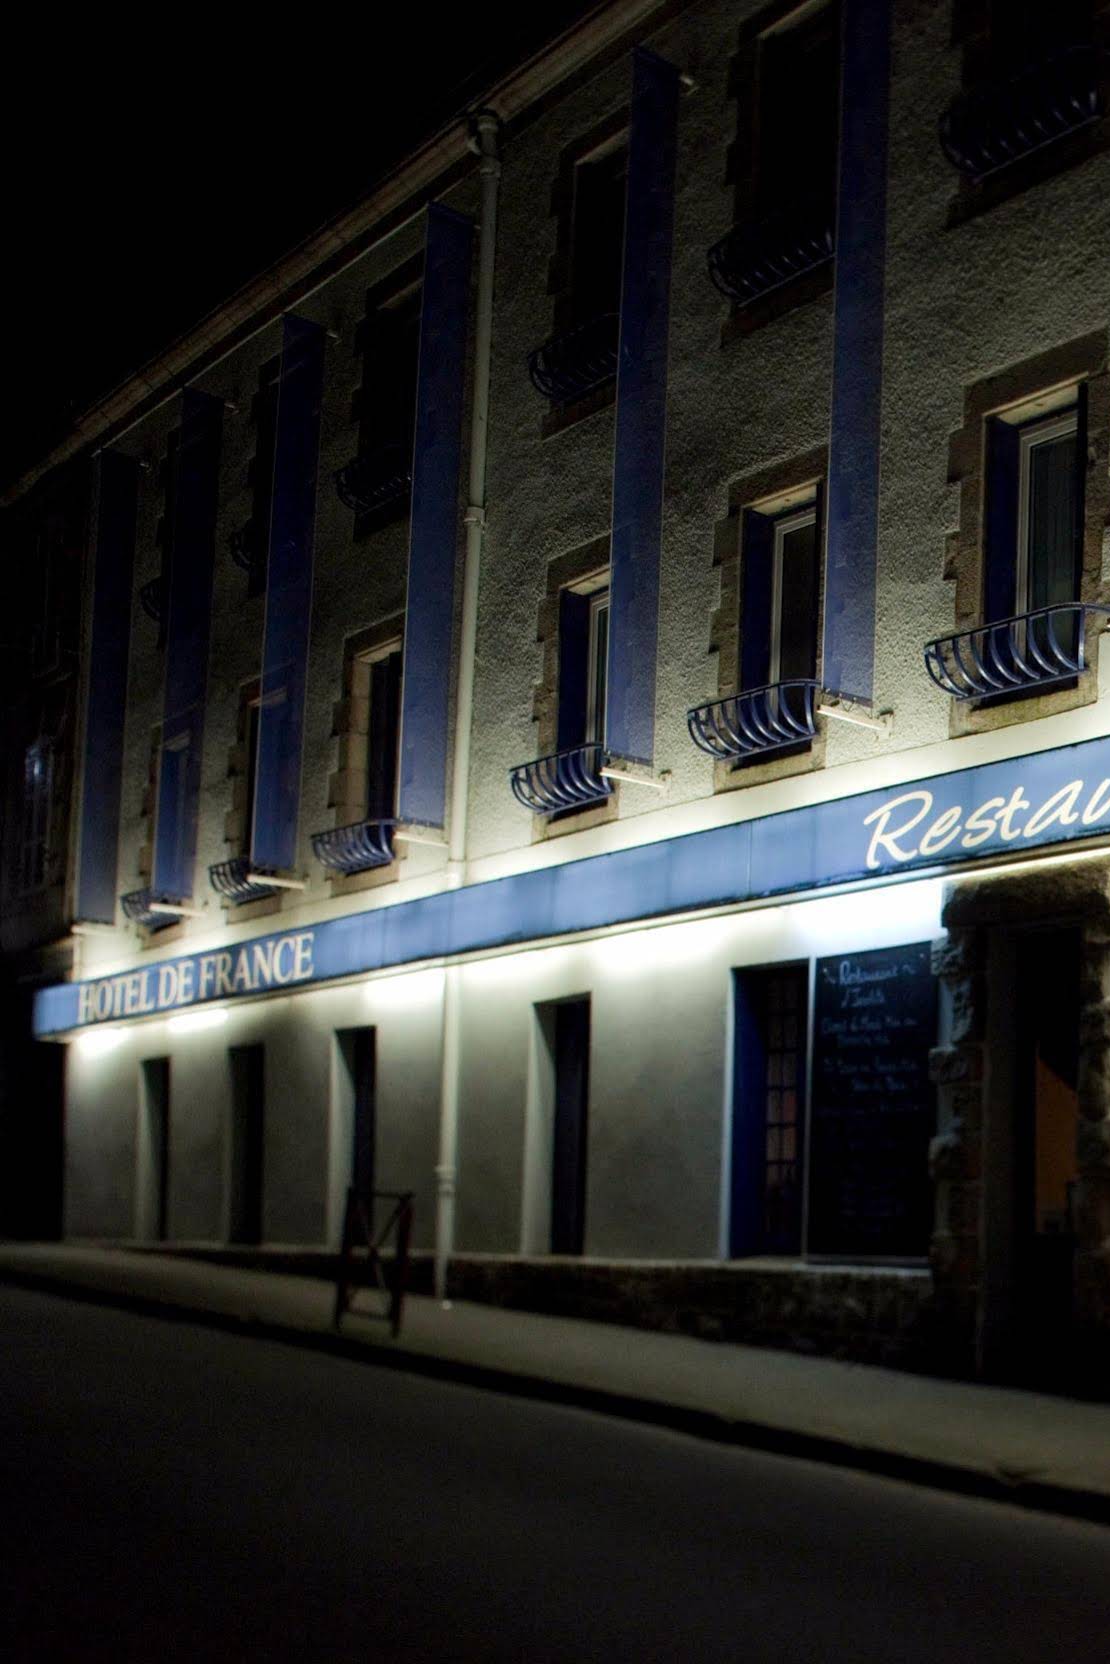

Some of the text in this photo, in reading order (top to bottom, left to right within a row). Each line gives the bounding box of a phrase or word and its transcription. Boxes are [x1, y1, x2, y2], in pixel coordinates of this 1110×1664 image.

[77, 932, 315, 1025] HOTEL DE FRANCE
